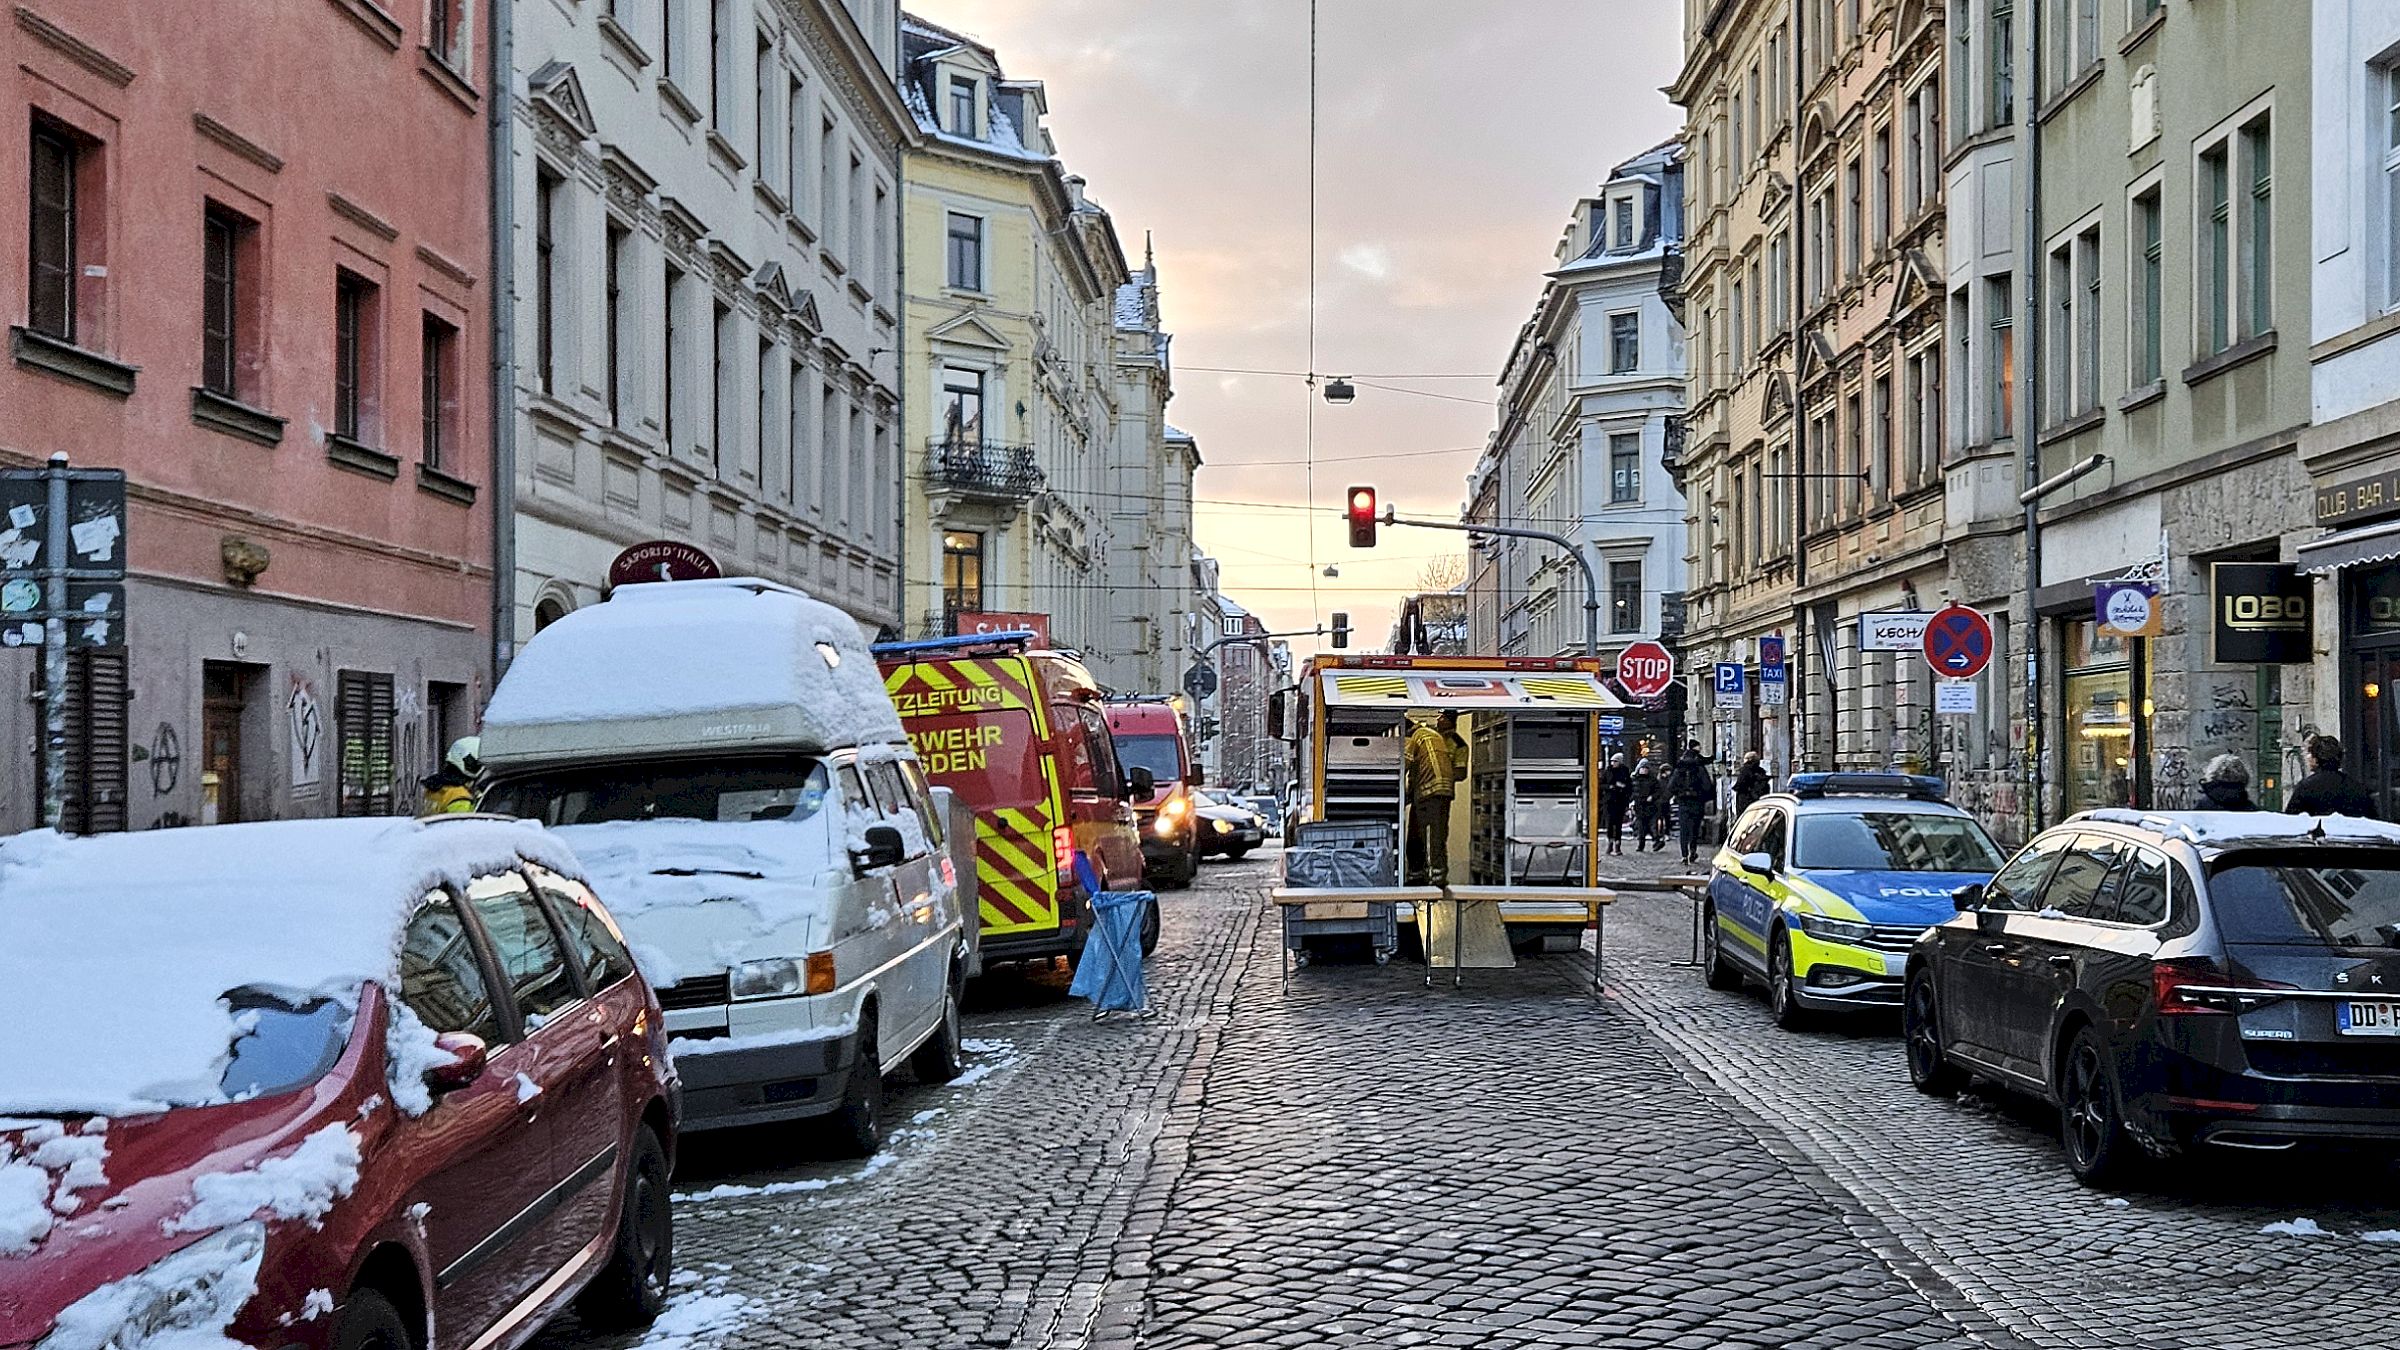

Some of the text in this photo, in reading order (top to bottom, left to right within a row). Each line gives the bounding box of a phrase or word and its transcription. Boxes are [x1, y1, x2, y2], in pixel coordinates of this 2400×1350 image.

[2318, 491, 2347, 519] CLUB
[2357, 482, 2383, 510] BAR
[620, 546, 661, 571] SAPORI
[2225, 595, 2305, 627] LOBO
[1622, 657, 1668, 680] STOP
[1762, 667, 1783, 678] TAXI
[1879, 887, 1953, 898] POLI
[2351, 1004, 2377, 1027] DD
